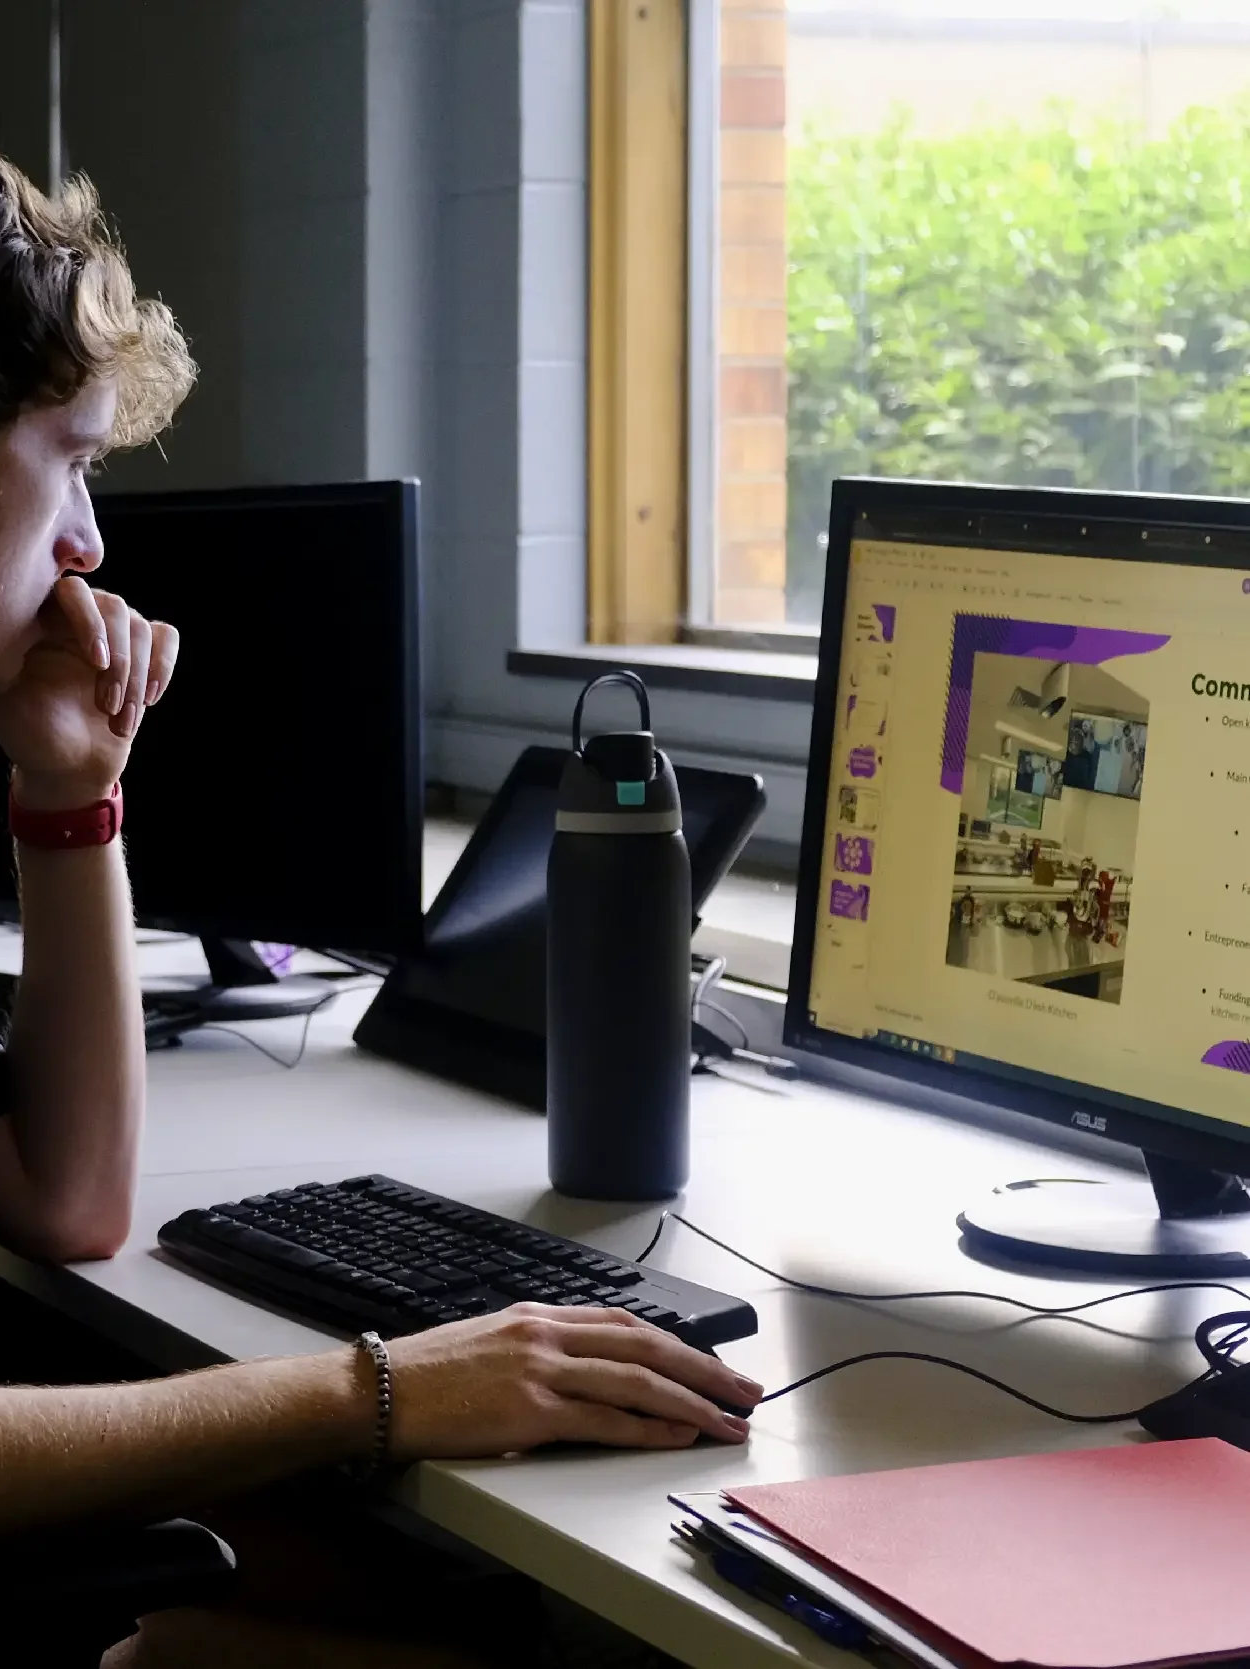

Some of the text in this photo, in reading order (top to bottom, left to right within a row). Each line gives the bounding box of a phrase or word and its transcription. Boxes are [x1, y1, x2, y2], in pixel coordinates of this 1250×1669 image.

[1222, 715, 1244, 728] Open
[1226, 771, 1248, 784] Main
[1071, 1110, 1107, 1132] ASUS
